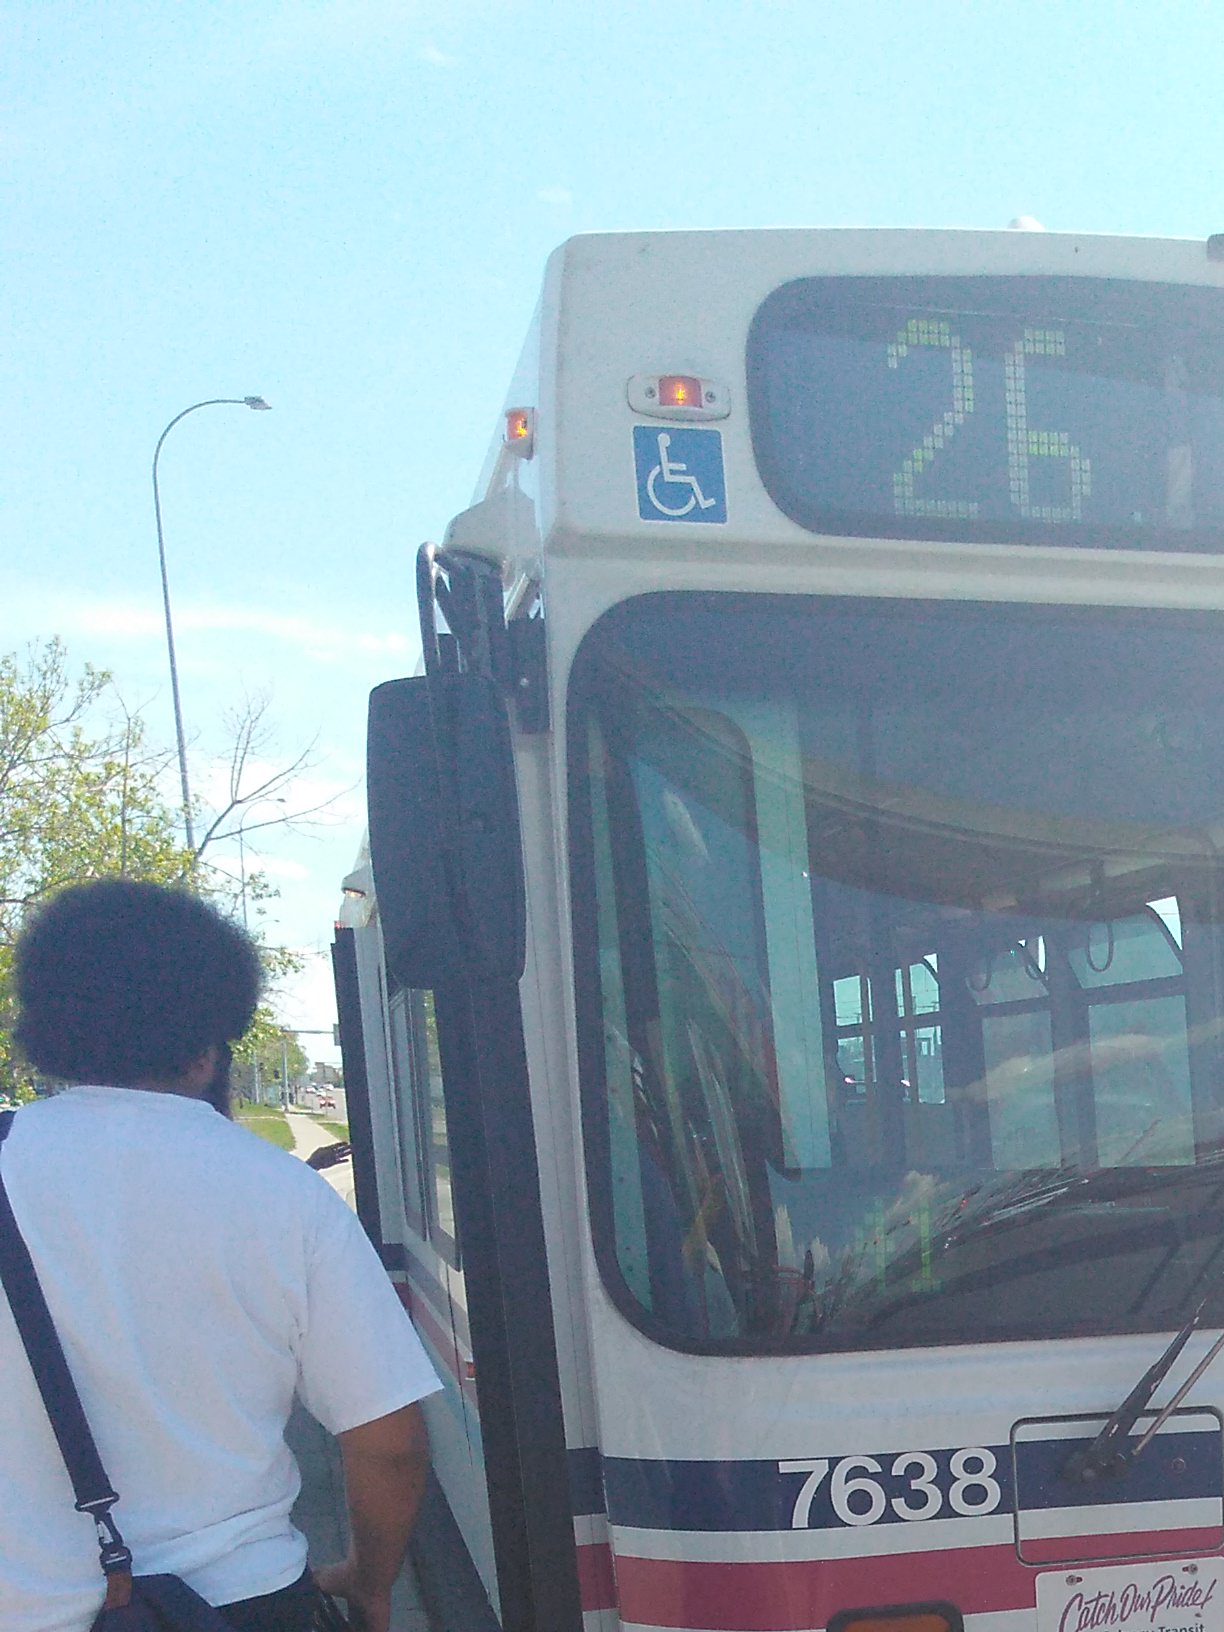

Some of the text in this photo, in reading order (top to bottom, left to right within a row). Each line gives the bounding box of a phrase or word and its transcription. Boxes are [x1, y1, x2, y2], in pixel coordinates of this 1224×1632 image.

[887, 319, 1092, 520] 26
[778, 1447, 1002, 1528] 7638
[1119, 1583, 1151, 1622] Our
